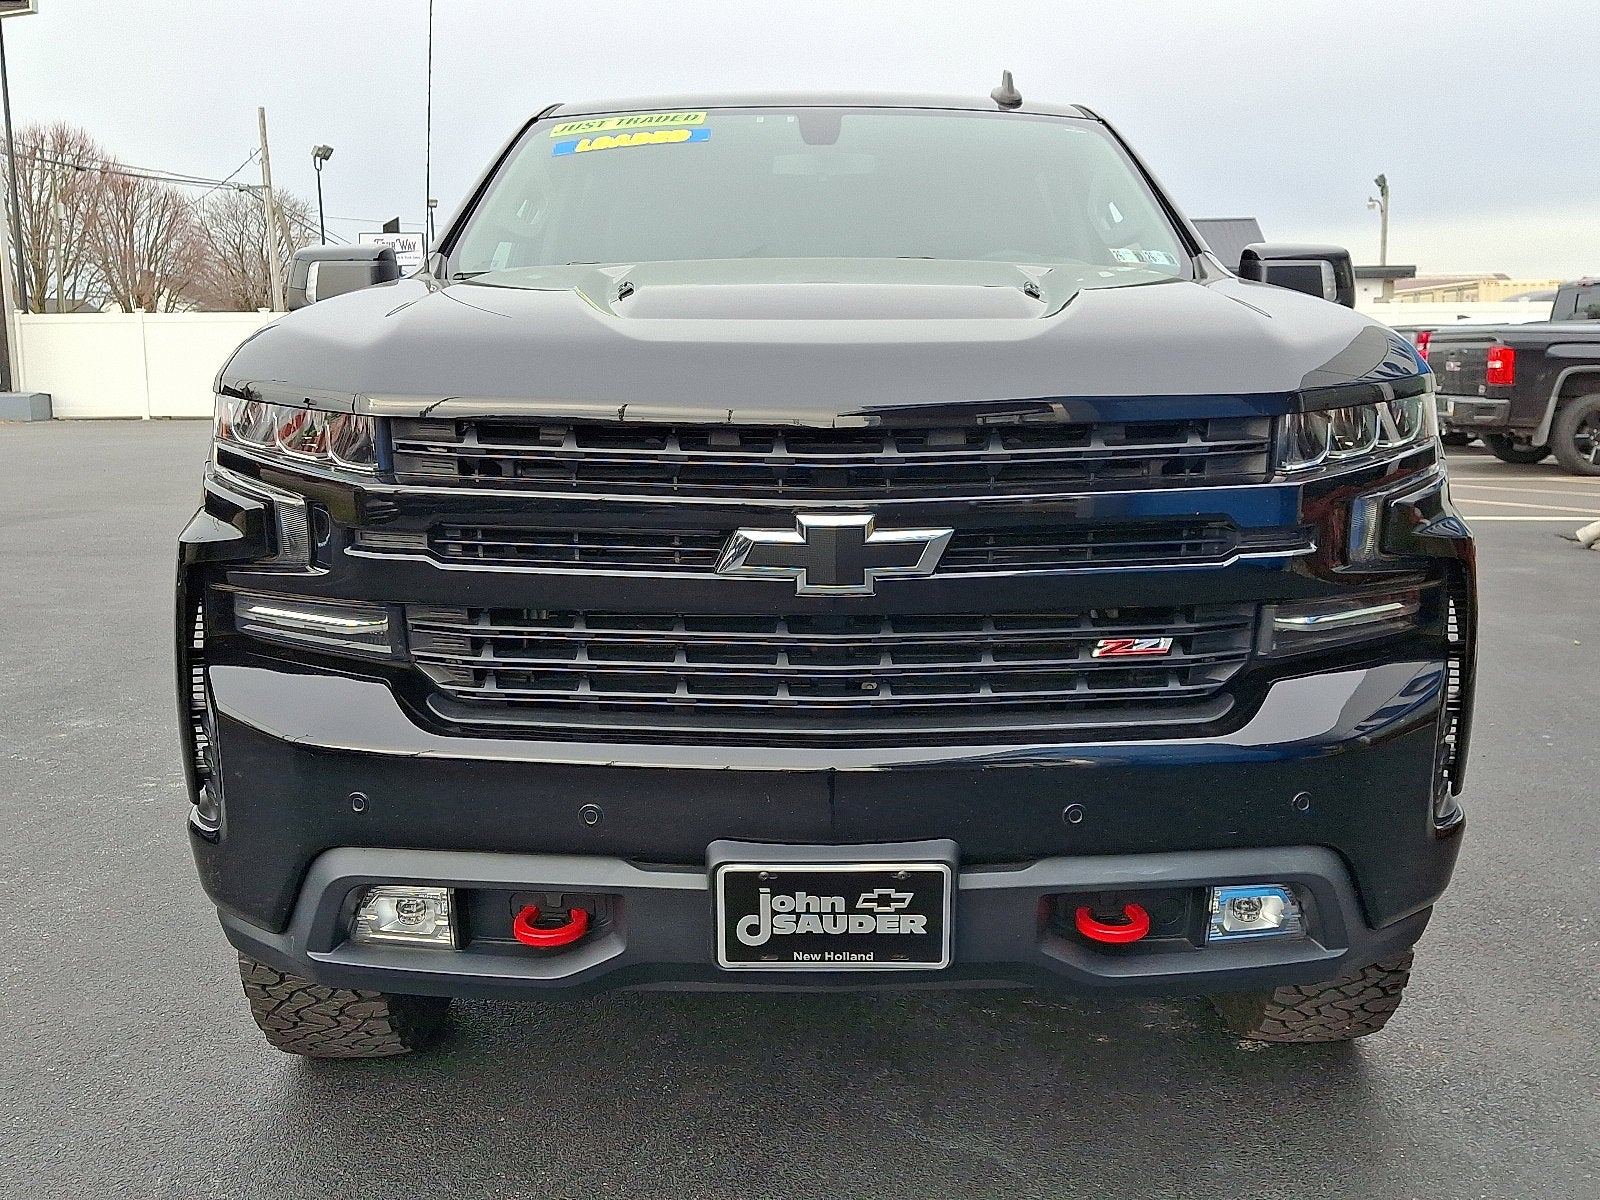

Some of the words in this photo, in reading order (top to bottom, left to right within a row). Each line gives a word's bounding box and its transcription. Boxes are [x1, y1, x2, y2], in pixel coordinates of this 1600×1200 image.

[554, 120, 609, 134] JUST
[616, 113, 700, 127] TRADED
[575, 129, 692, 153] LOADED
[1092, 637, 1174, 658] Z71
[772, 914, 928, 935] SAUDER
[793, 951, 822, 962] New
[824, 951, 875, 962] Holland
